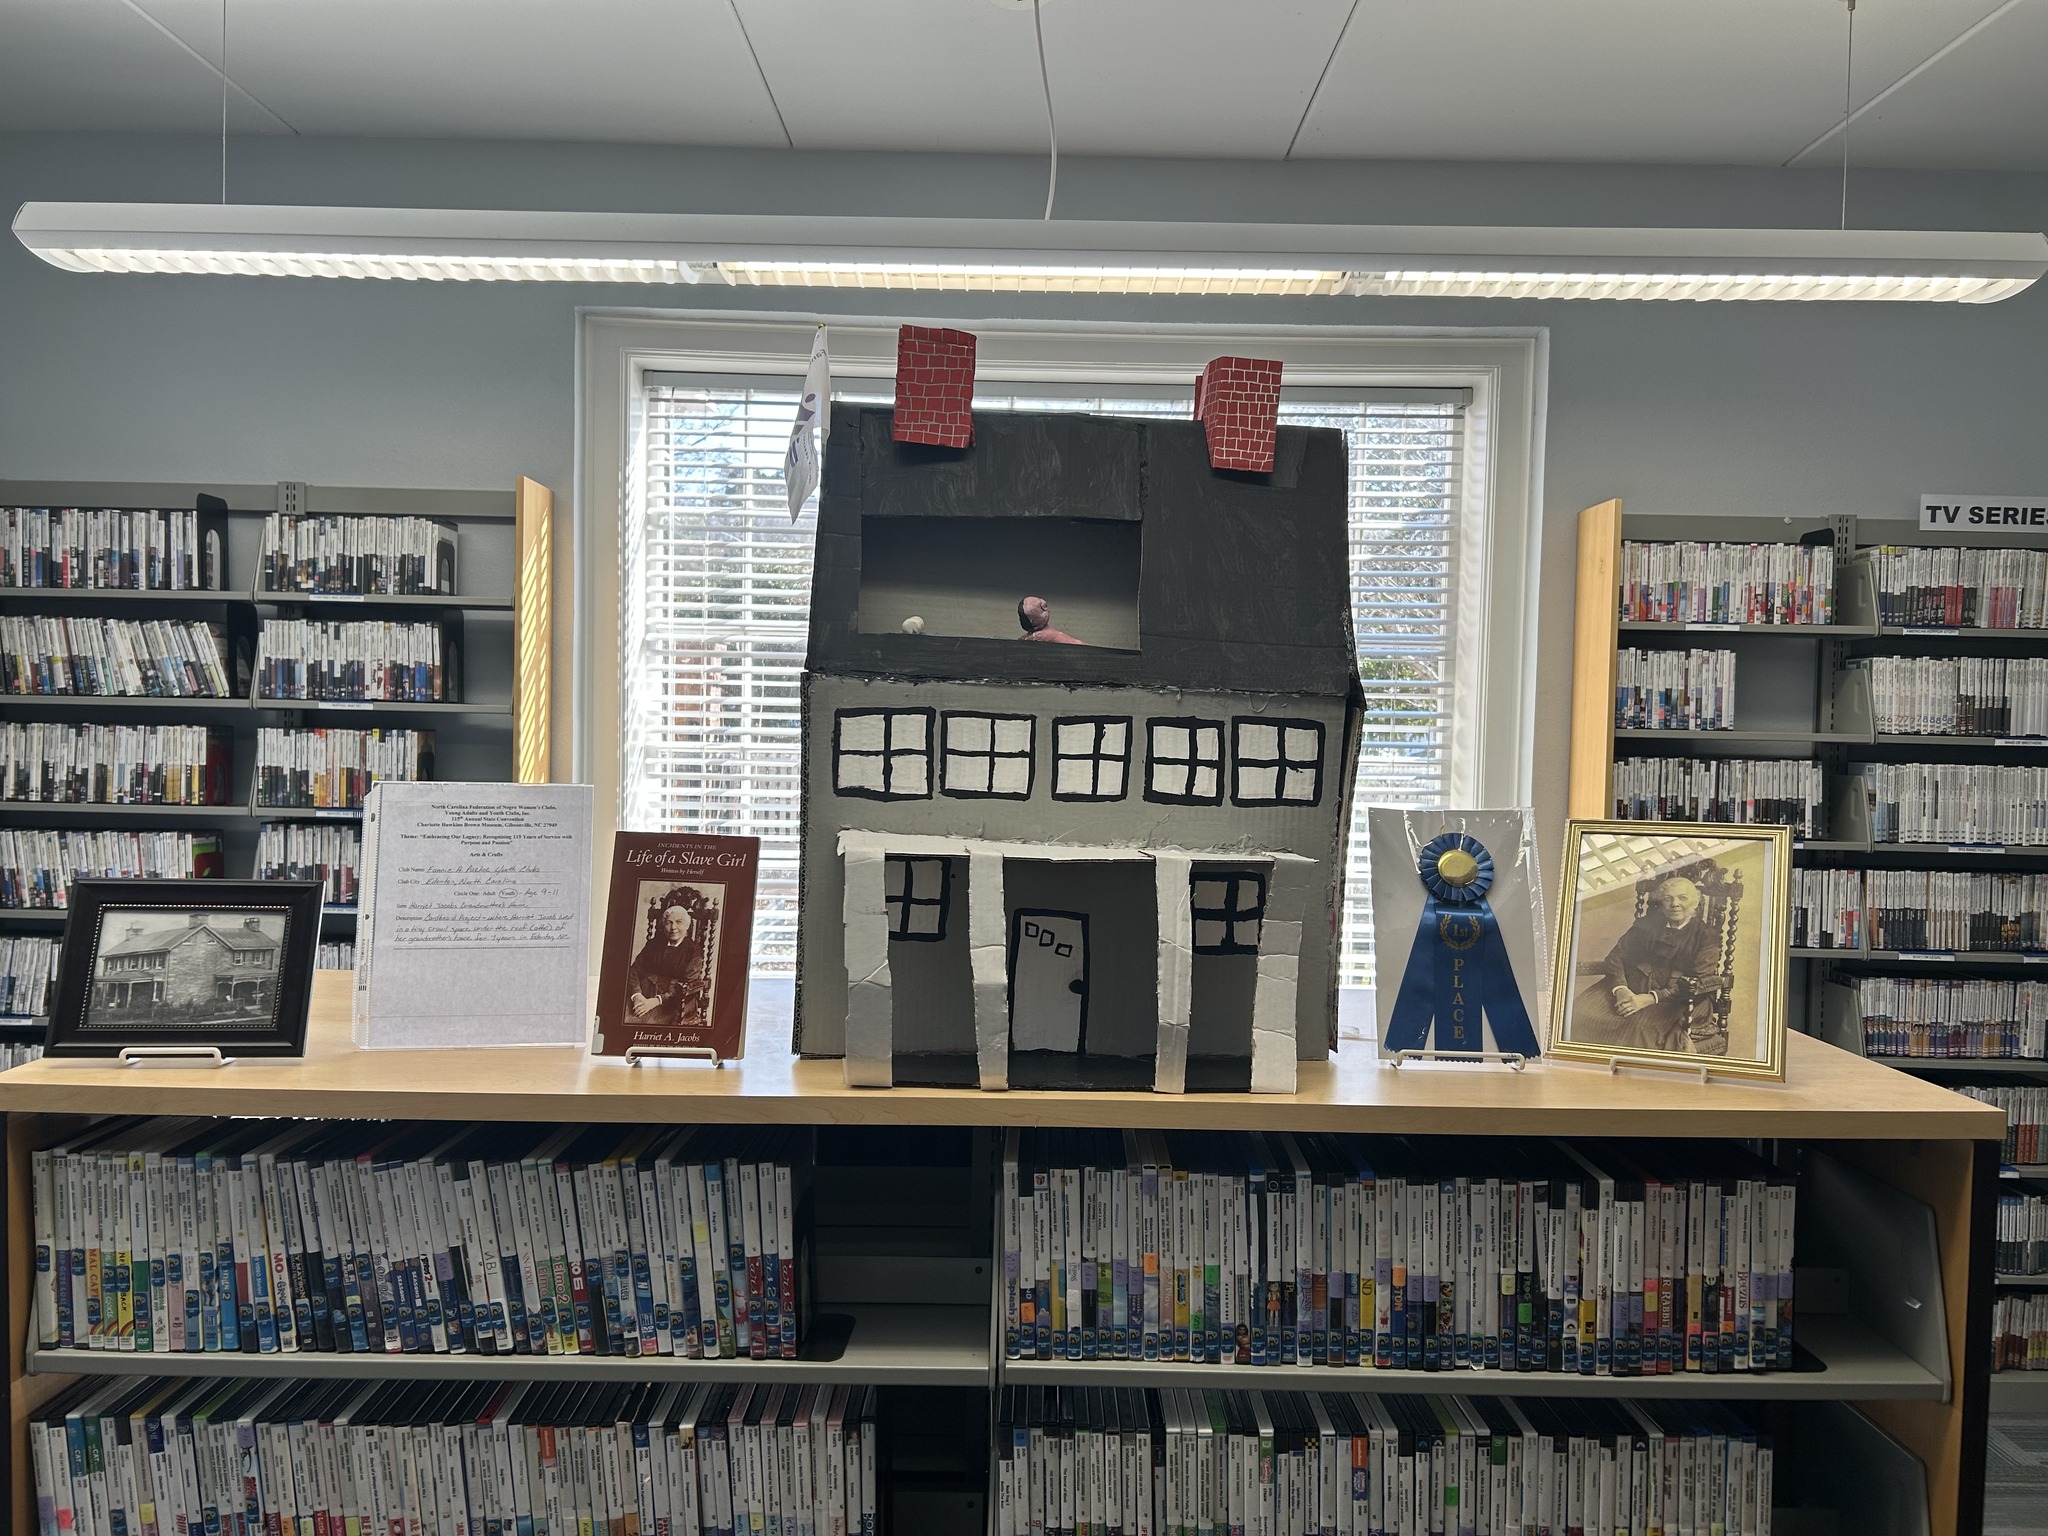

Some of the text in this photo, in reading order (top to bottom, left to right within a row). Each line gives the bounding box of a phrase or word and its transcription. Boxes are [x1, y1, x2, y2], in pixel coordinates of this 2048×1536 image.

[1925, 505, 2048, 526] TV SERIE
[626, 849, 747, 868] Life of a Slave Girl
[679, 868, 686, 876] by
[686, 868, 705, 876] Herself
[1452, 923, 1470, 938] 1st
[1453, 958, 1465, 1040] PLACE
[633, 1031, 700, 1044] Harriet A. Jacobs
[396, 1275, 405, 1302] SEASONS
[411, 1271, 420, 1299] SEASONS
[537, 1267, 550, 1297] Elmo
[553, 1263, 570, 1304] Elmo 2
[1523, 1275, 1531, 1299] FROG
[1737, 1271, 1749, 1309] Beezus
[119, 1292, 127, 1312] BACK
[1007, 1278, 1018, 1315] Splash
[1660, 1291, 1672, 1328] RABBIT
